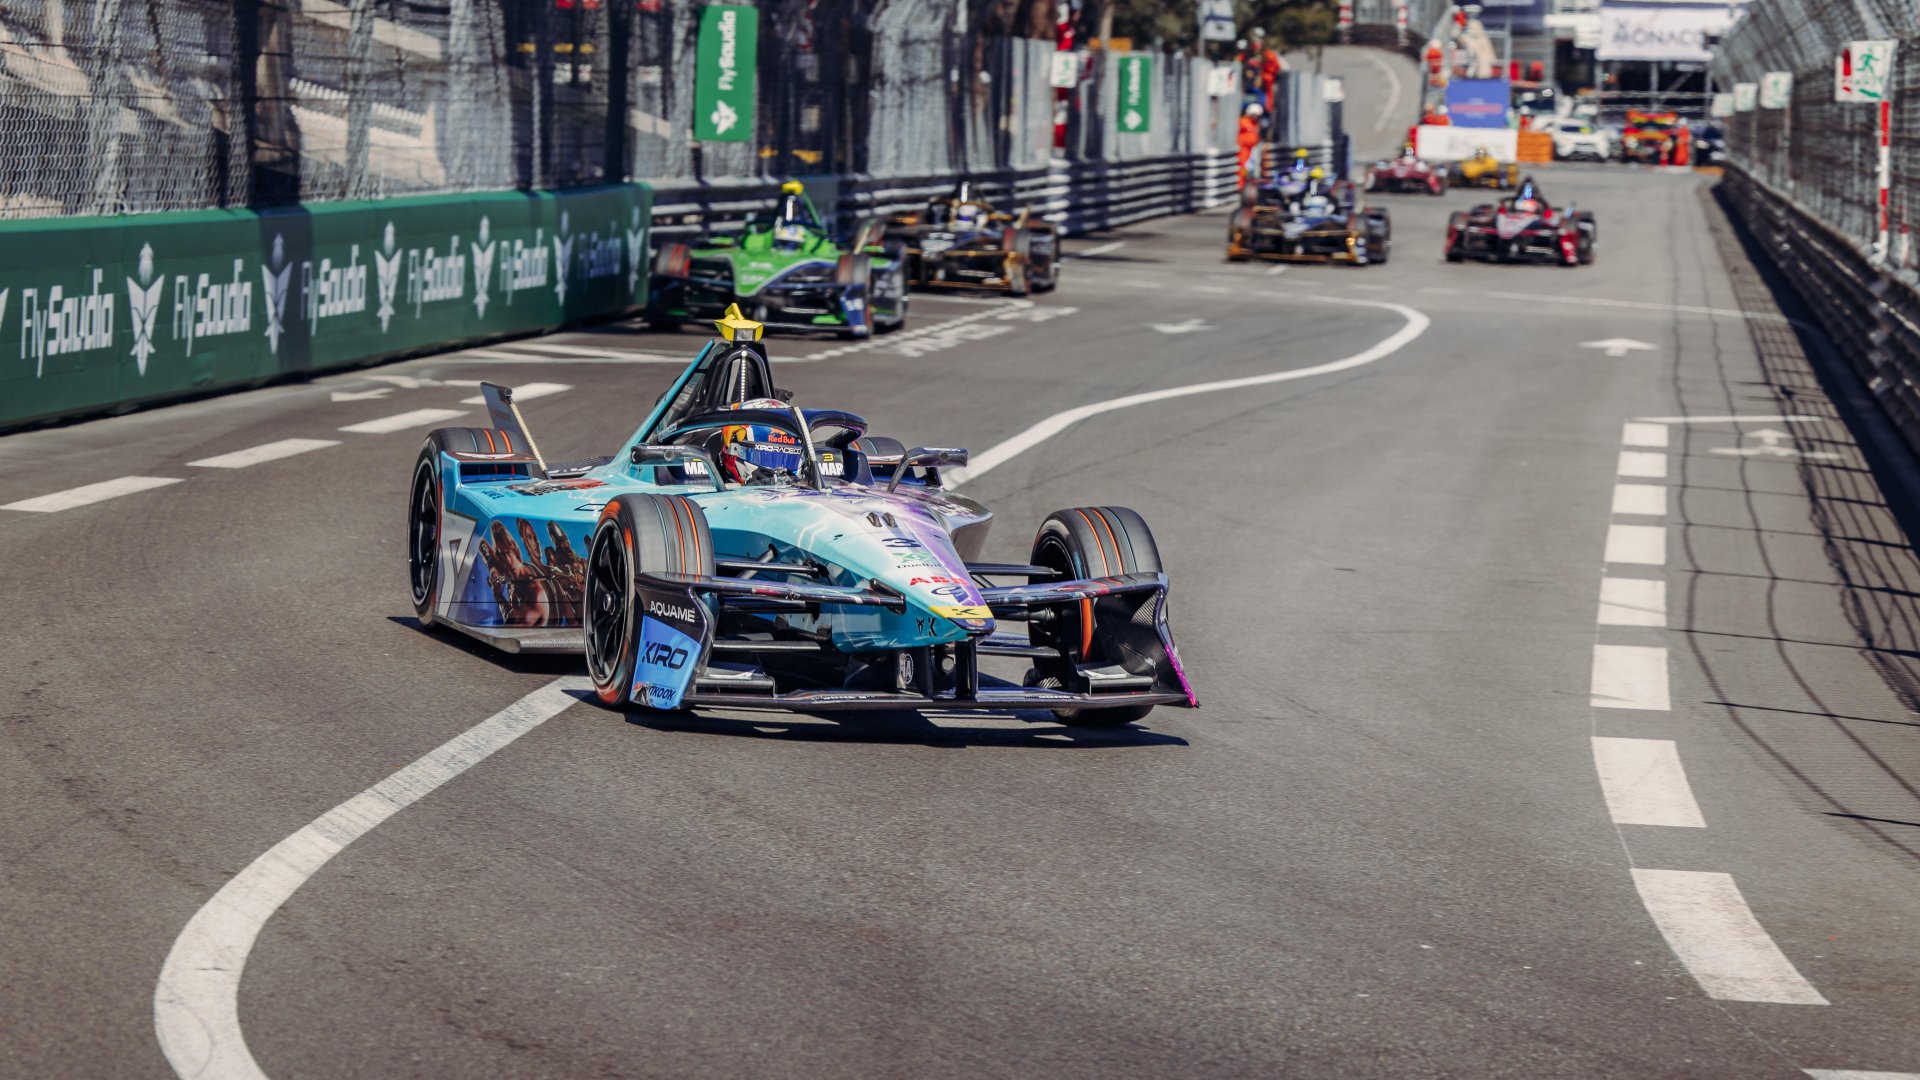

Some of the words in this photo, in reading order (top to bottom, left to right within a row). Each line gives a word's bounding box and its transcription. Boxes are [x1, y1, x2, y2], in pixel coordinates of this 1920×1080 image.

[718, 10, 738, 90] FlySaudia
[172, 258, 252, 358] FlySaudia
[300, 244, 367, 336] FlySaudia
[407, 235, 465, 319] FlySaudia
[20, 268, 114, 378] FlySaudia
[684, 461, 709, 475] MA
[823, 453, 834, 462] 3
[881, 537, 921, 548] 3
[909, 575, 969, 587] ABB
